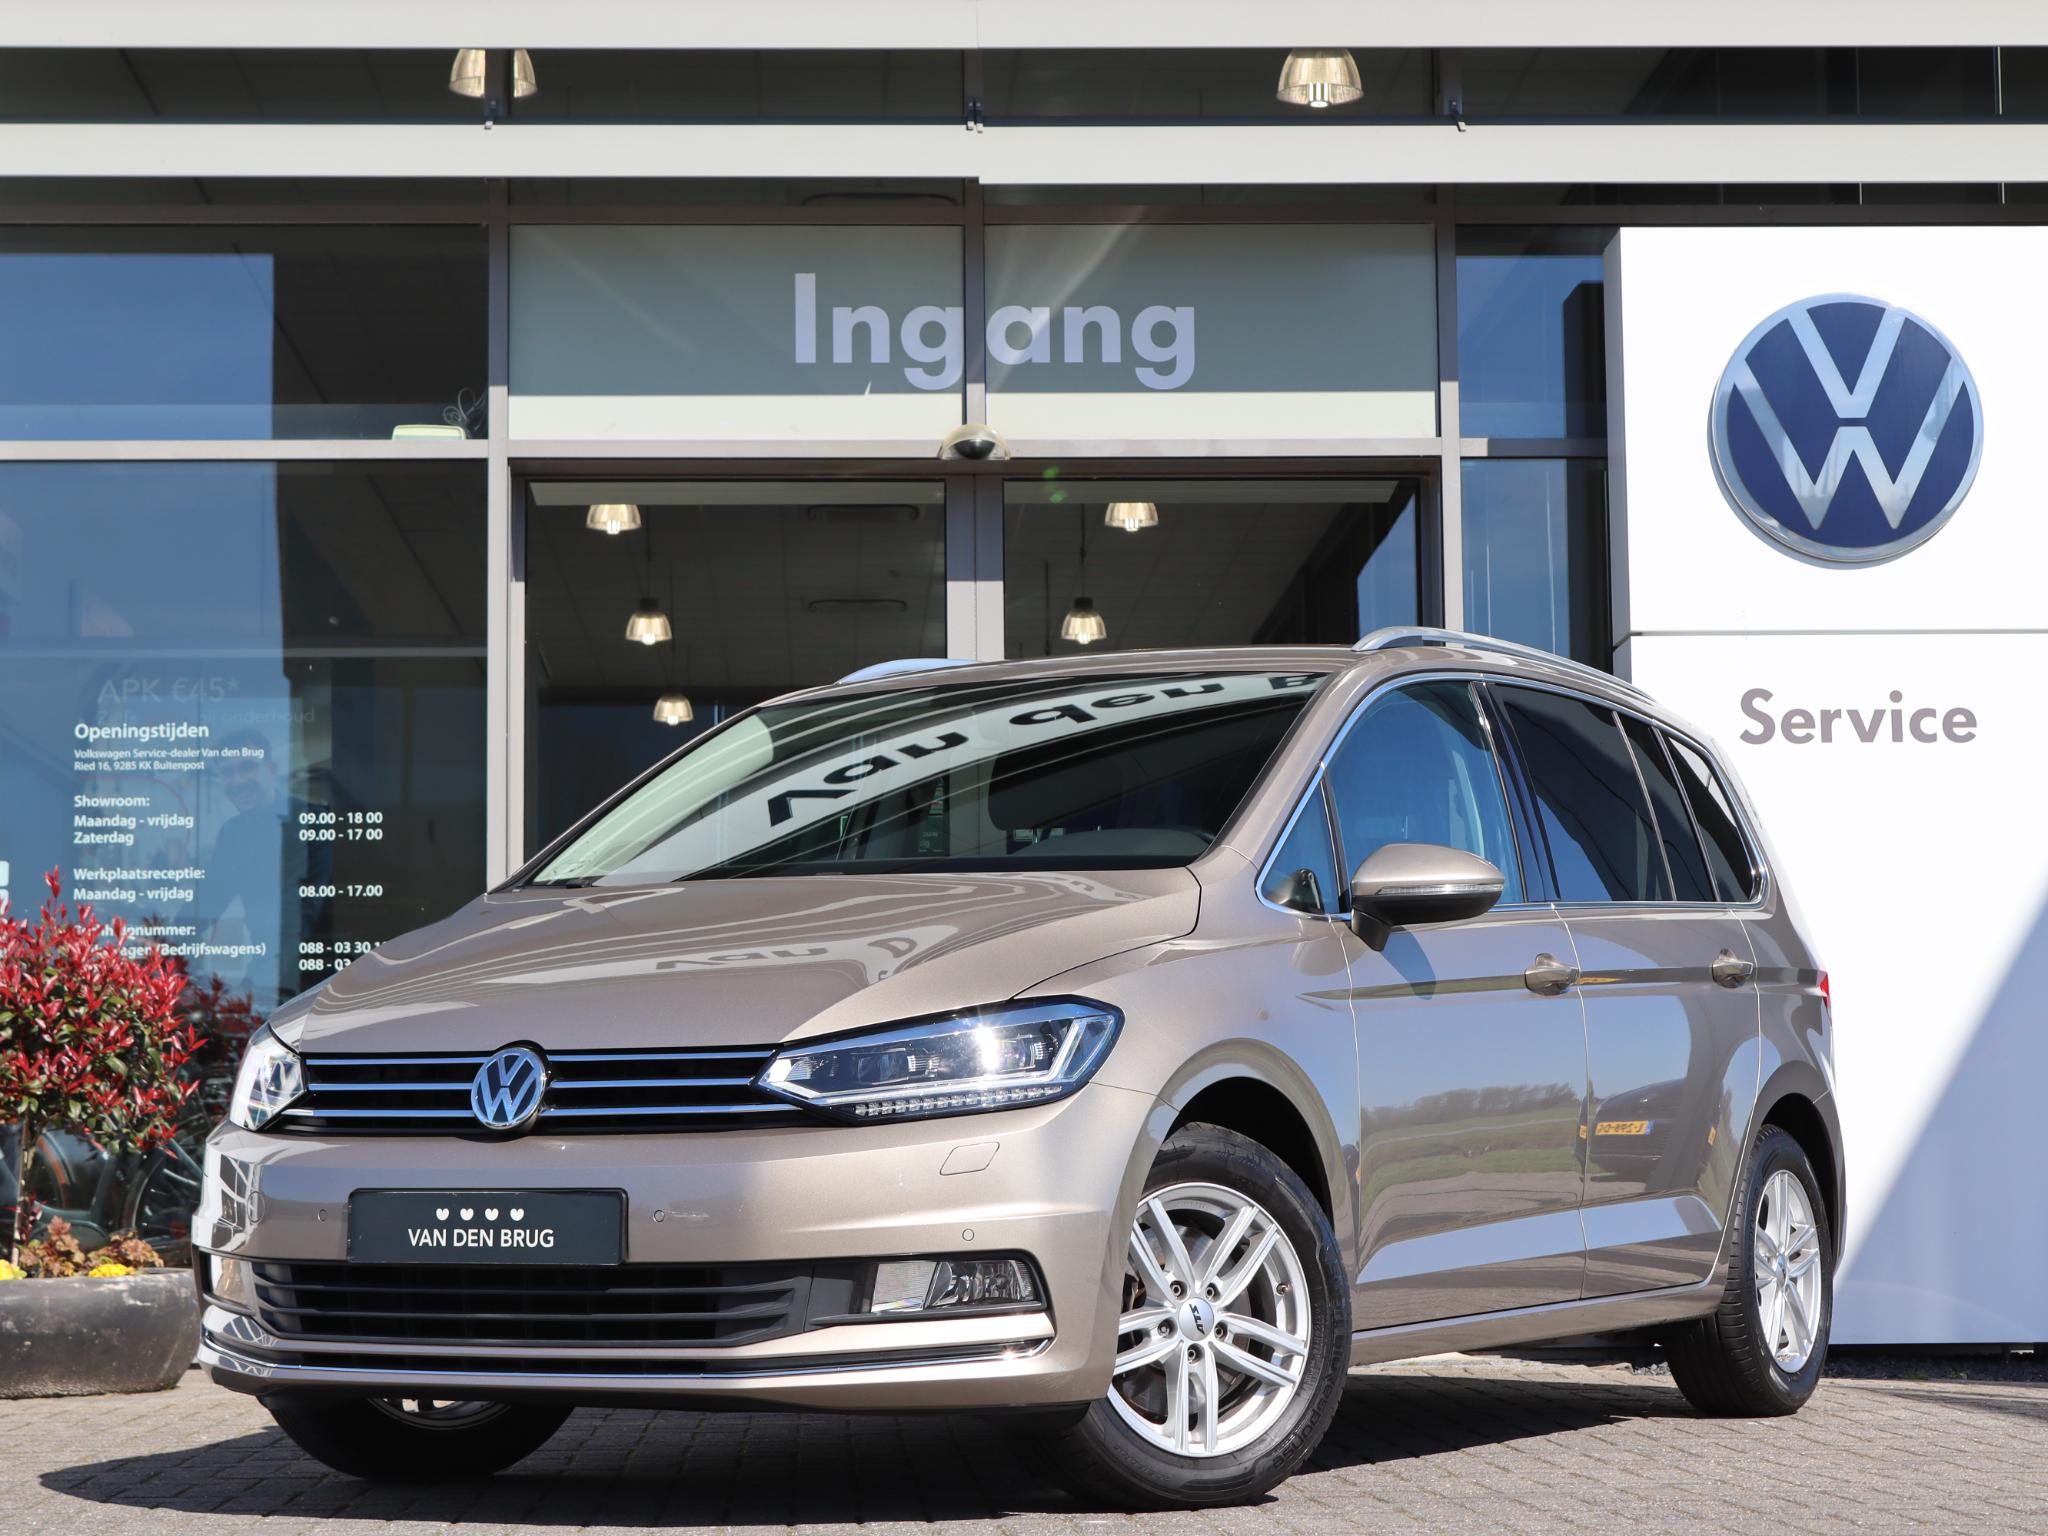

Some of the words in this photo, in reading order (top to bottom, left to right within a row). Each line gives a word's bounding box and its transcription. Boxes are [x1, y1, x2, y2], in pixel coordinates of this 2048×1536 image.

[794, 272, 1197, 391] Ingang
[97, 678, 162, 703] APK
[1739, 687, 1978, 745] Service
[74, 721, 210, 742] Openingstijden
[74, 748, 131, 760] Volkswagen
[132, 747, 200, 759] Service-dealer
[201, 748, 219, 758] Van
[221, 747, 240, 758] den
[242, 747, 264, 760] Brug
[74, 760, 96, 771] Ried
[98, 760, 112, 772] 16,
[113, 760, 137, 771] 9285
[138, 760, 152, 771] KK
[153, 760, 205, 772] Buitenpost
[73, 794, 151, 808] Showroom:
[73, 814, 136, 829] Maandag
[147, 813, 194, 829] vrijdag
[299, 812, 336, 825] 09.00
[73, 832, 134, 846] Zaterdag
[299, 829, 336, 841] 09.00
[73, 867, 206, 882] Werkplaatsreceptie:
[73, 887, 136, 903] Maandag
[147, 886, 194, 902] vrijdag
[299, 884, 336, 897] 08.00
[347, 884, 383, 897] 17.00
[299, 942, 324, 954] 088
[334, 942, 351, 954] 03
[353, 941, 371, 953] 30
[299, 959, 324, 971] 088
[408, 1229, 447, 1247] VAN
[453, 1229, 494, 1247] DEN
[500, 1229, 555, 1248] BRUG
